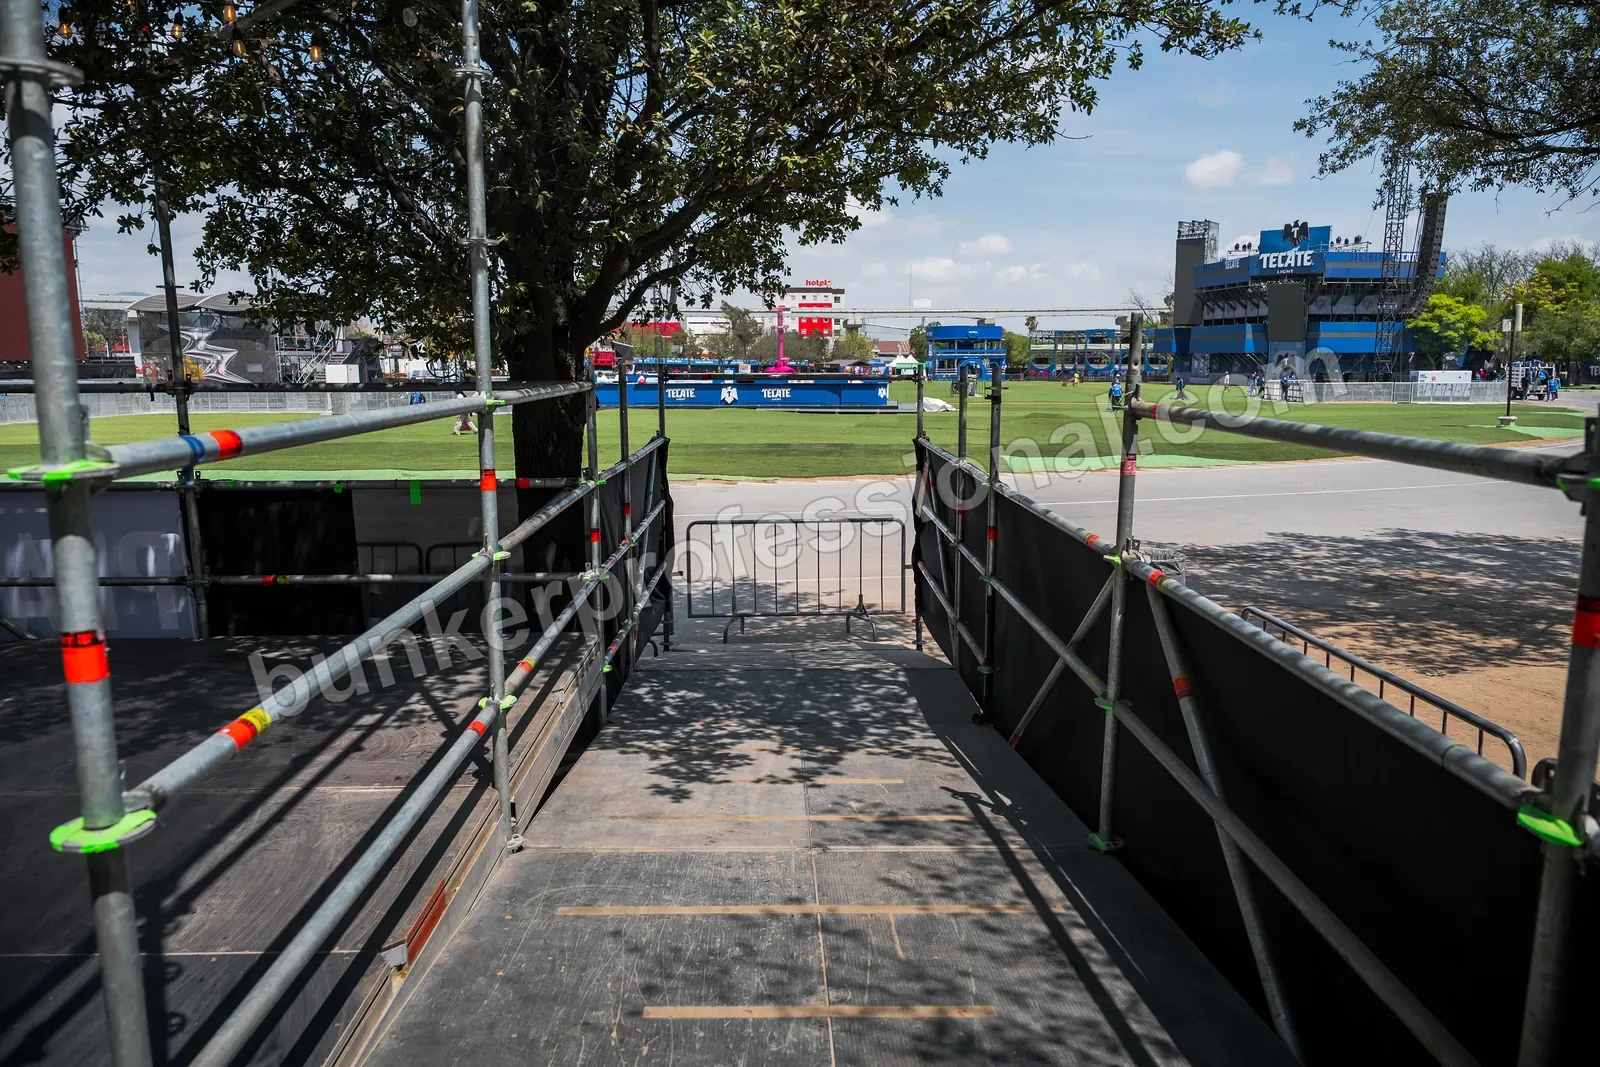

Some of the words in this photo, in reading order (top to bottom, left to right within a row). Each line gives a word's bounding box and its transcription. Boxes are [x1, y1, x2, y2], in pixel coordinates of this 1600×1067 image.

[1258, 248, 1314, 269] TECATE
[665, 388, 696, 398] TECATE
[761, 388, 791, 398] TECATE
